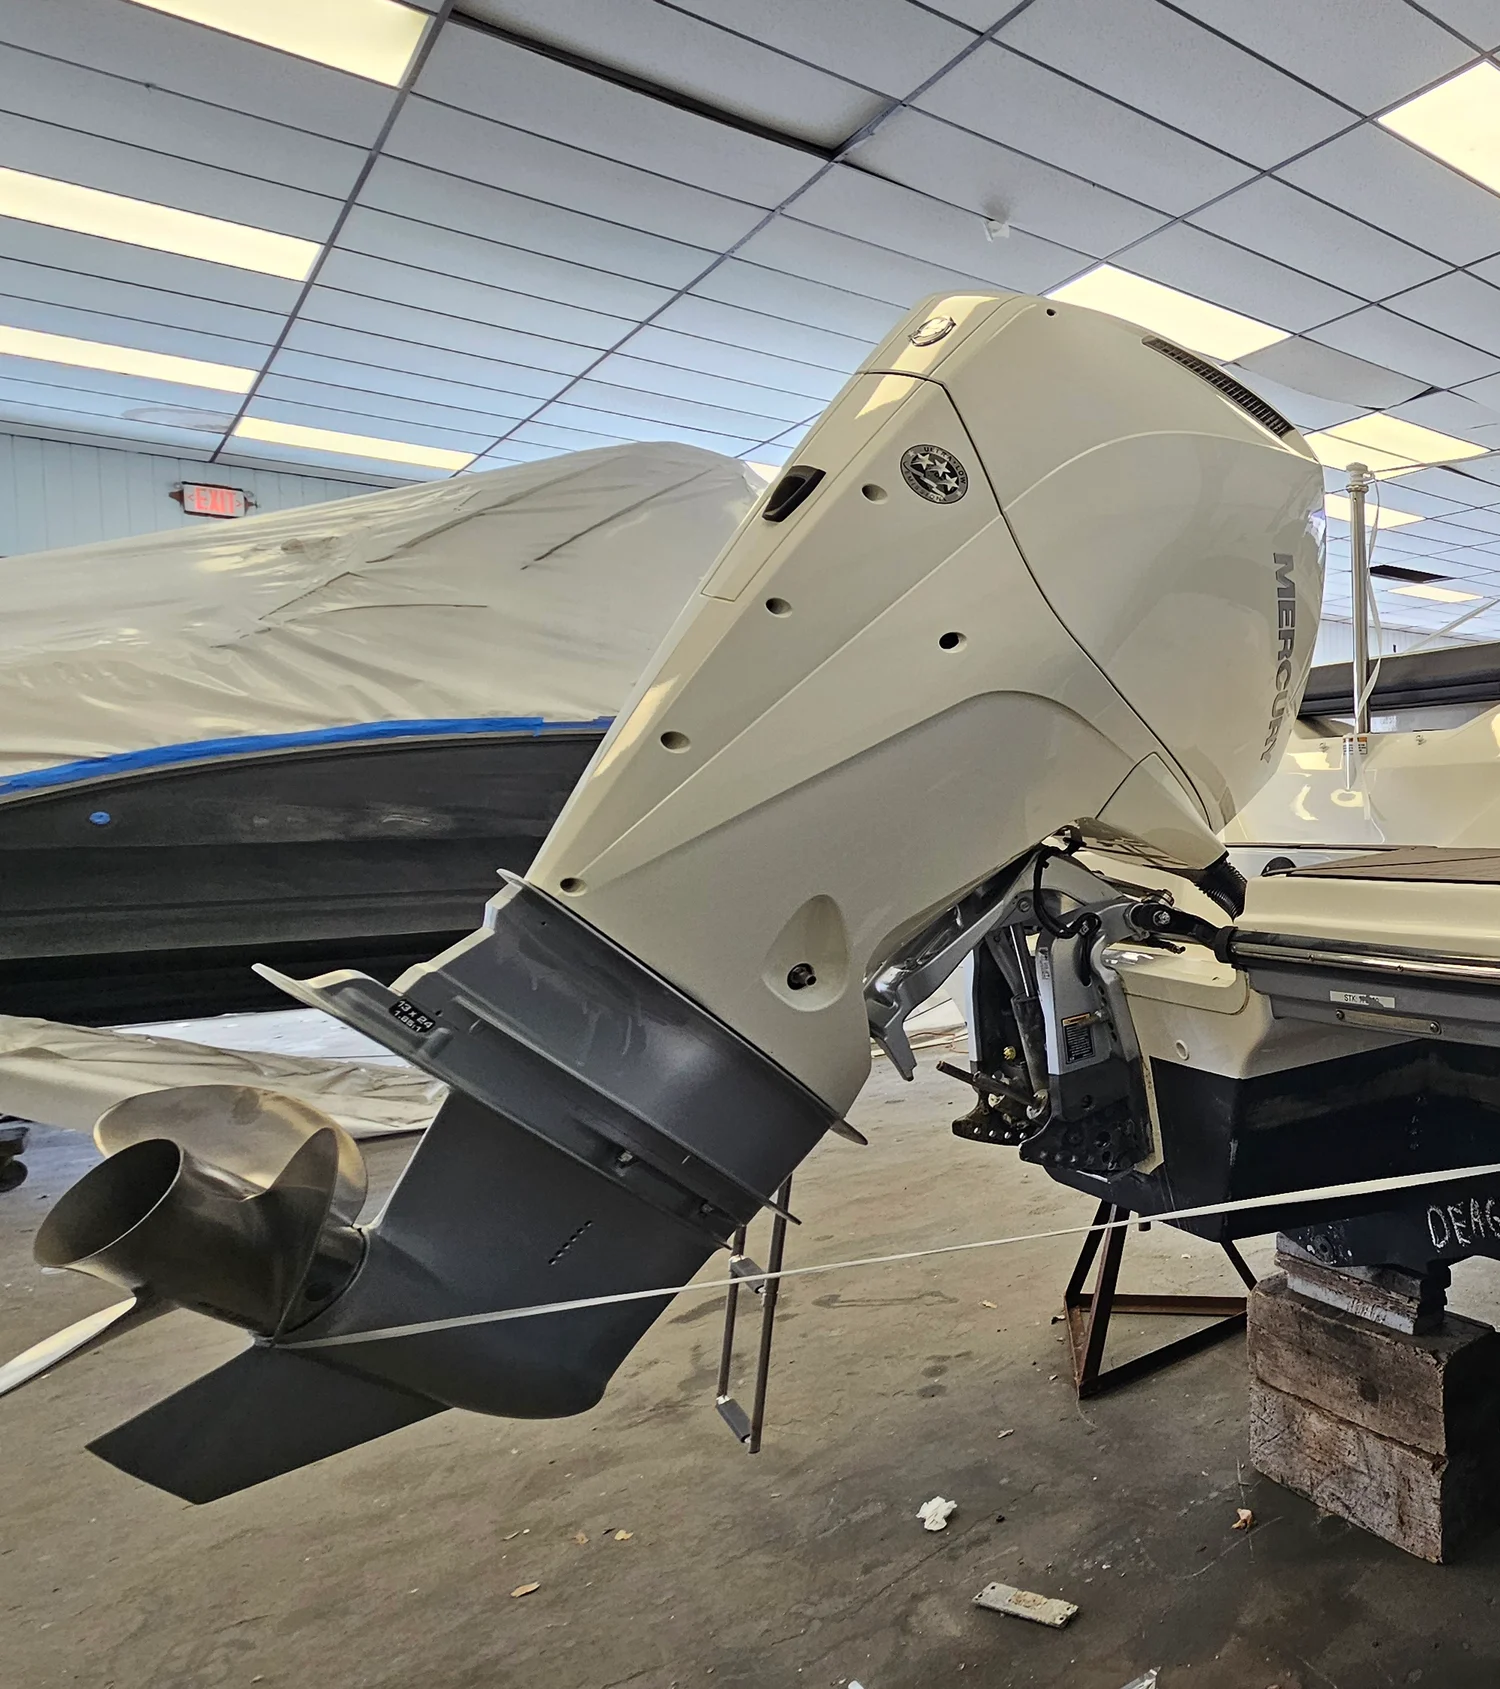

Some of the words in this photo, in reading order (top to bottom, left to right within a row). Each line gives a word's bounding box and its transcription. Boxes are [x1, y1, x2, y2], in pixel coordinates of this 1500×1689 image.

[195, 487, 236, 515] EXIT
[1260, 552, 1297, 764] MERCURY
[397, 1000, 412, 1012] 13
[416, 1015, 434, 1029] 24
